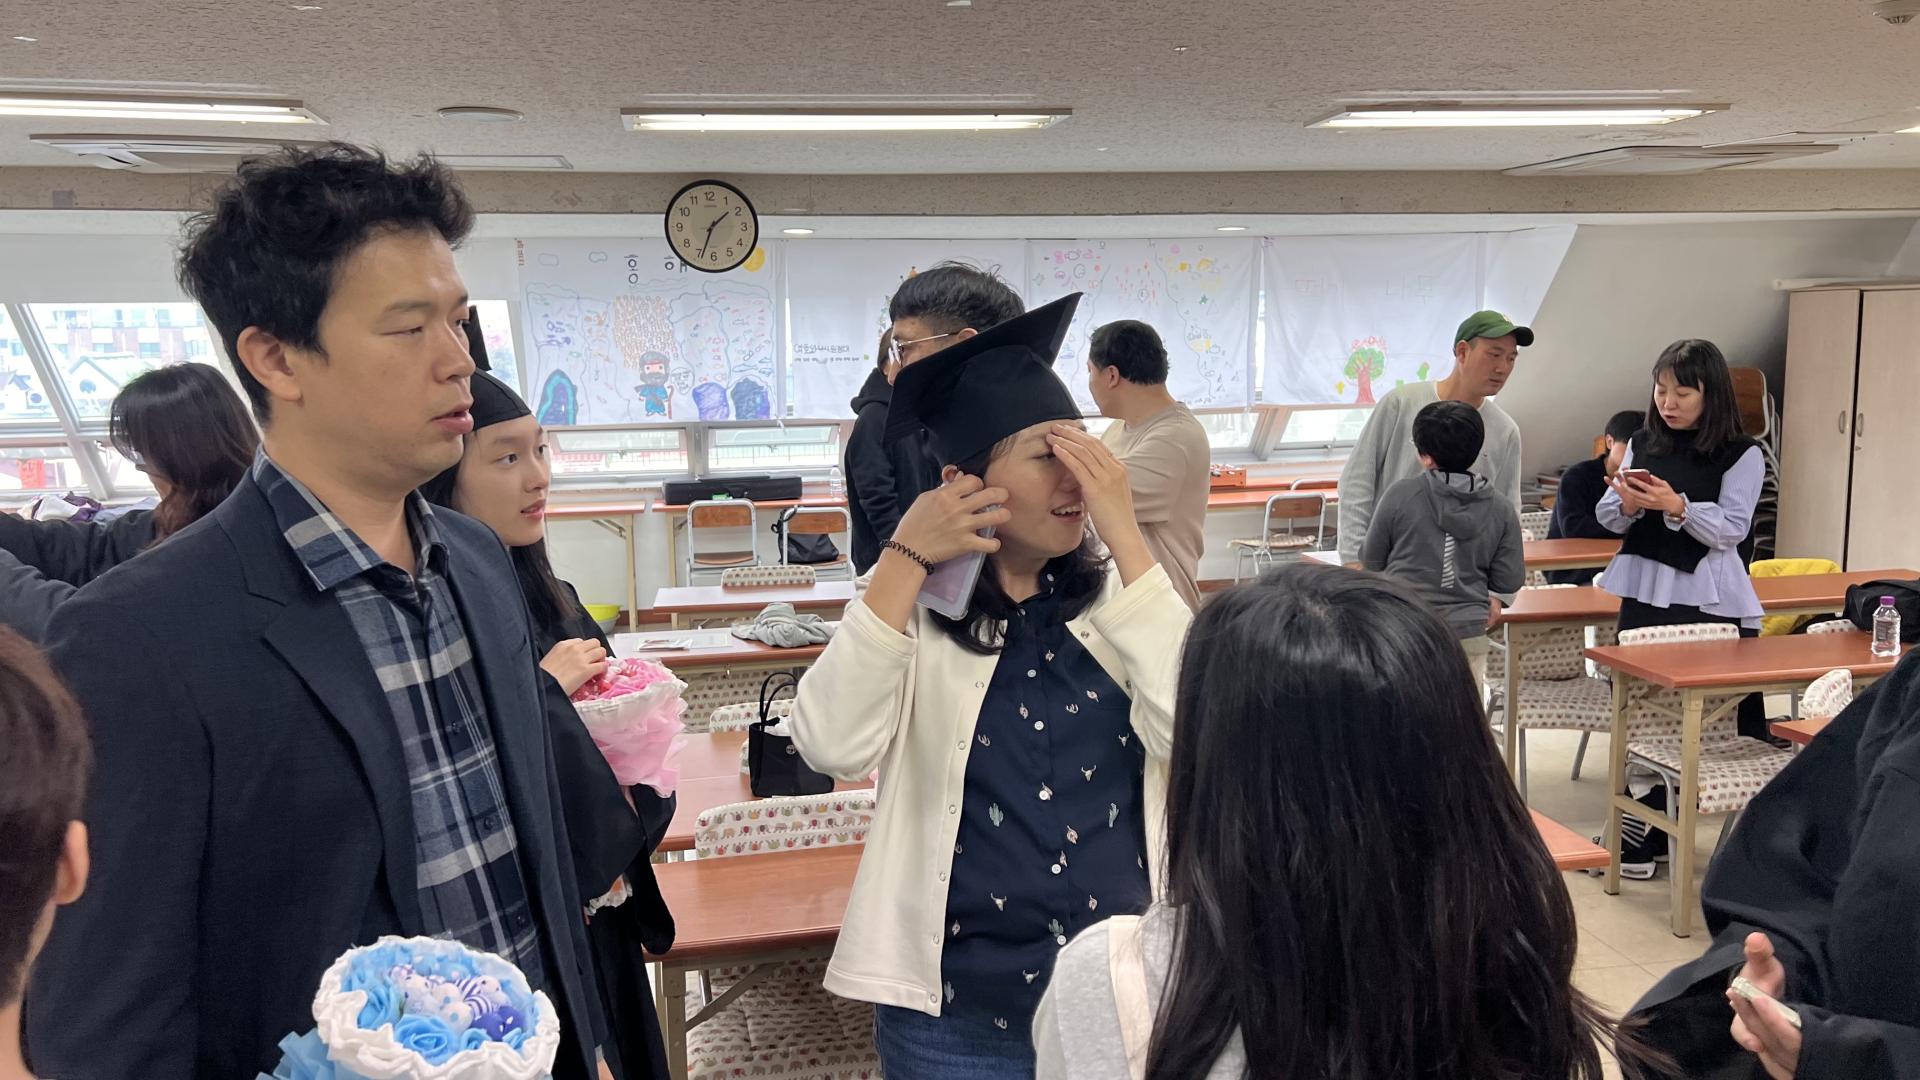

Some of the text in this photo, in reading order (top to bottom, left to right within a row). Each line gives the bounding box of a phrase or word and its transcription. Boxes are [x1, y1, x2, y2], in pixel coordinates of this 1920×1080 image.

[690, 196, 698, 205] 11
[704, 191, 715, 201] 12
[723, 196, 728, 205] 1
[680, 207, 690, 217] 10
[735, 206, 742, 216] 2
[676, 223, 683, 232] 9
[741, 222, 748, 231] 3
[683, 239, 691, 248] 8
[736, 239, 743, 247] 4
[696, 249, 702, 258] 7
[710, 252, 717, 261] 6
[726, 248, 733, 256] 5
